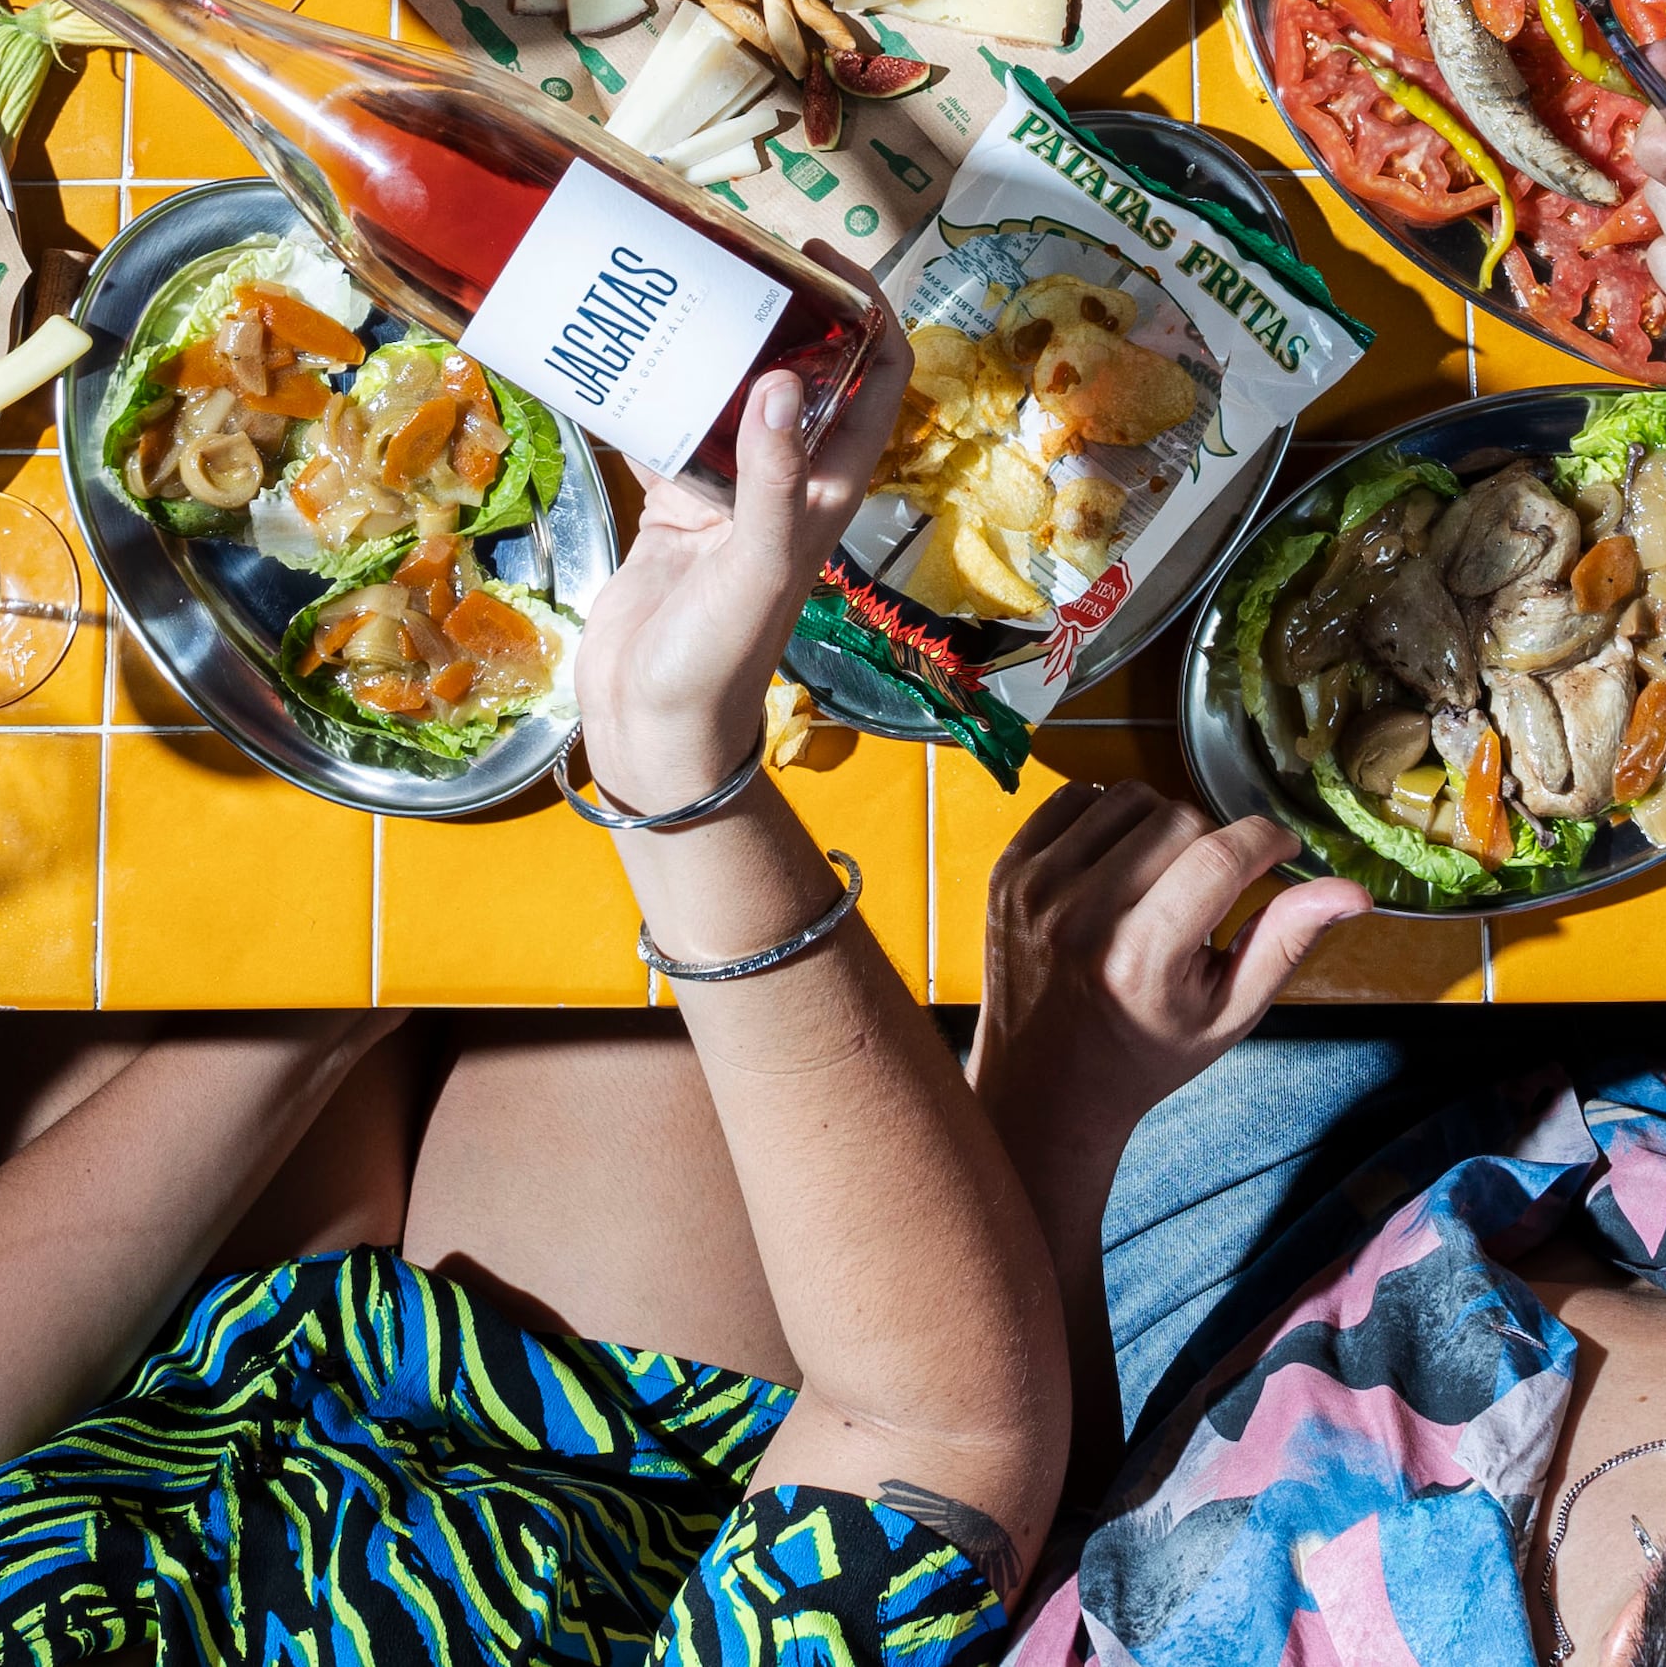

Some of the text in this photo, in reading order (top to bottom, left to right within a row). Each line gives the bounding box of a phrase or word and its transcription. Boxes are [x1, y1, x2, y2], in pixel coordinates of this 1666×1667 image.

[1007, 109, 1311, 374] PATATAS FRITAS
[544, 246, 679, 407] JAGATAS
[754, 288, 781, 324] ROSADO
[612, 386, 640, 420] SARA
